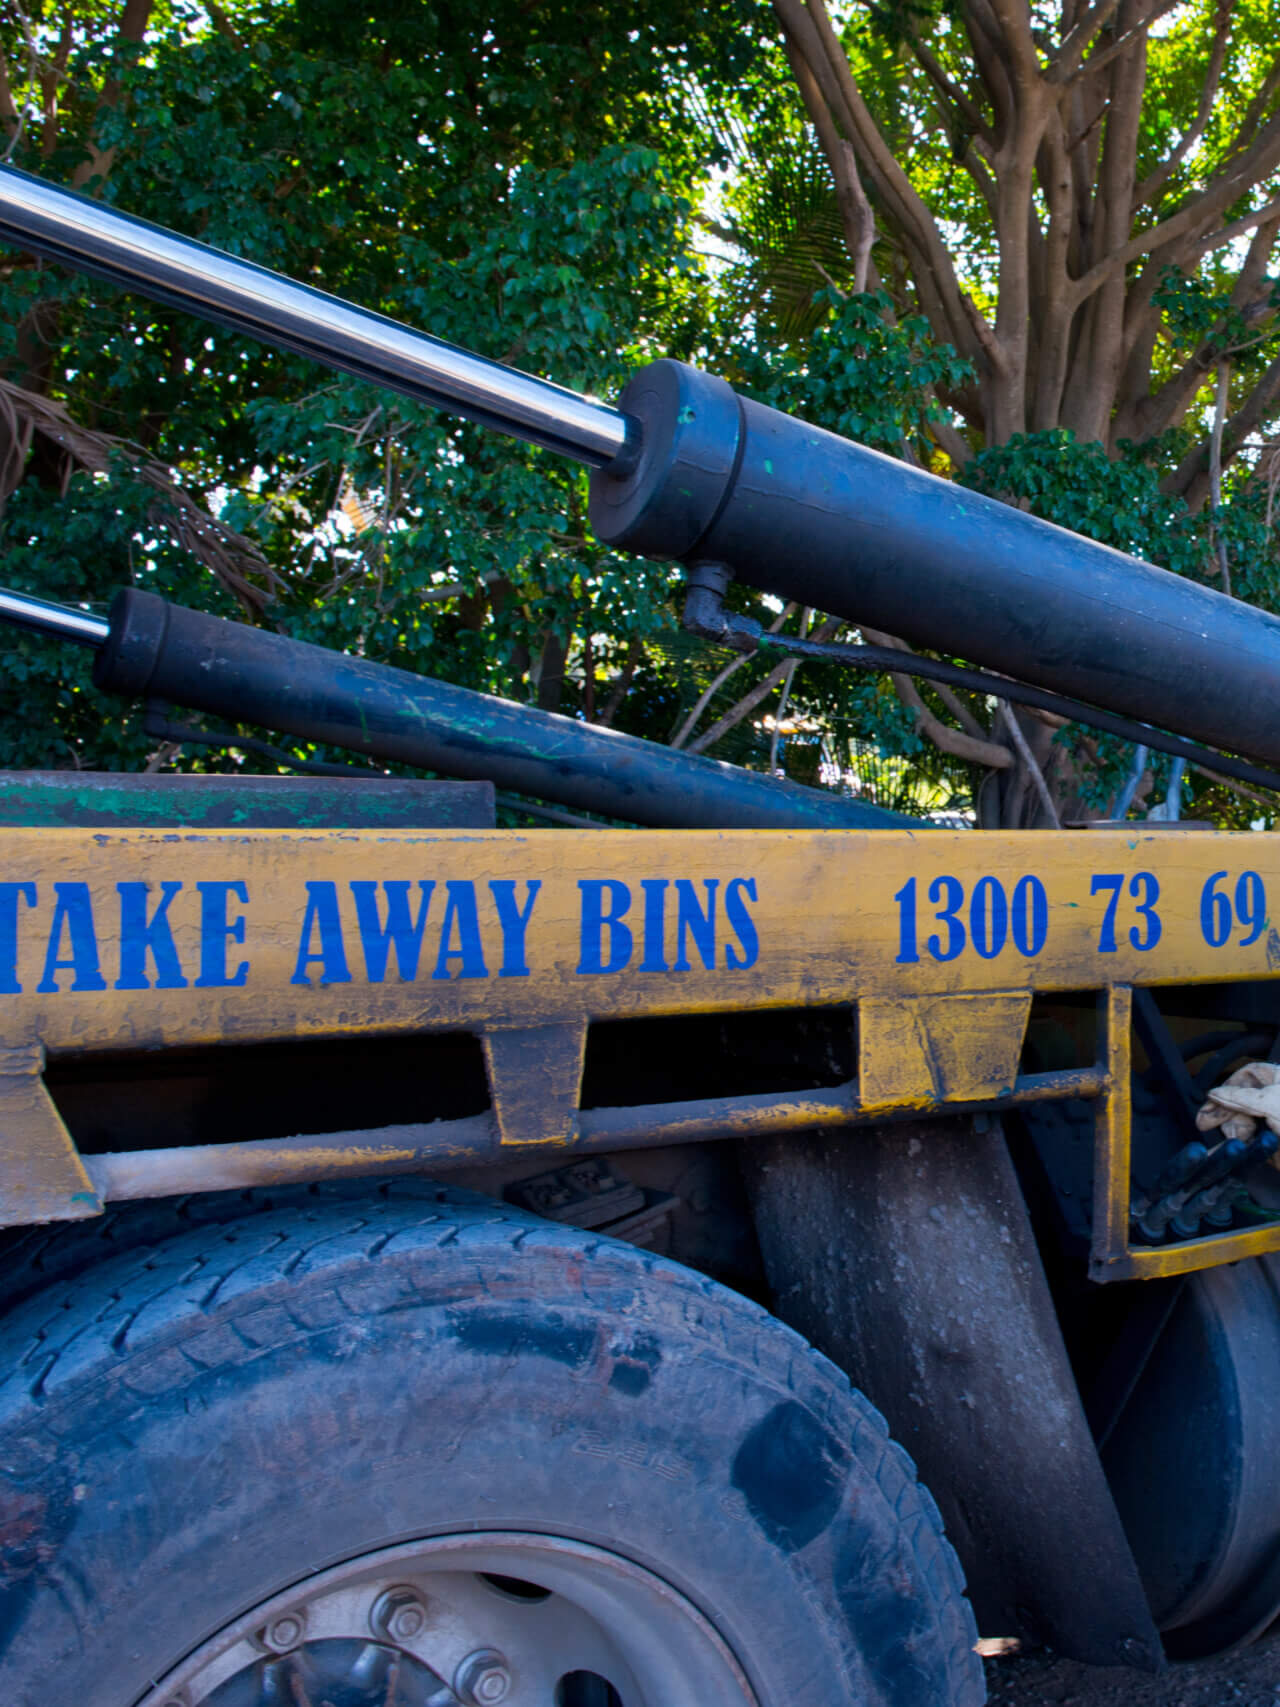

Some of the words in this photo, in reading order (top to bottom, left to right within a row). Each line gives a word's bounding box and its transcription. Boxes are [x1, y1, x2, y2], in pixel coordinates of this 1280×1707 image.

[0, 881, 250, 995] TAKE
[289, 880, 542, 985] AWAY
[576, 877, 760, 975] BINS
[894, 874, 1049, 964] 1300
[1090, 871, 1163, 953] 73
[1200, 870, 1268, 948] 69
